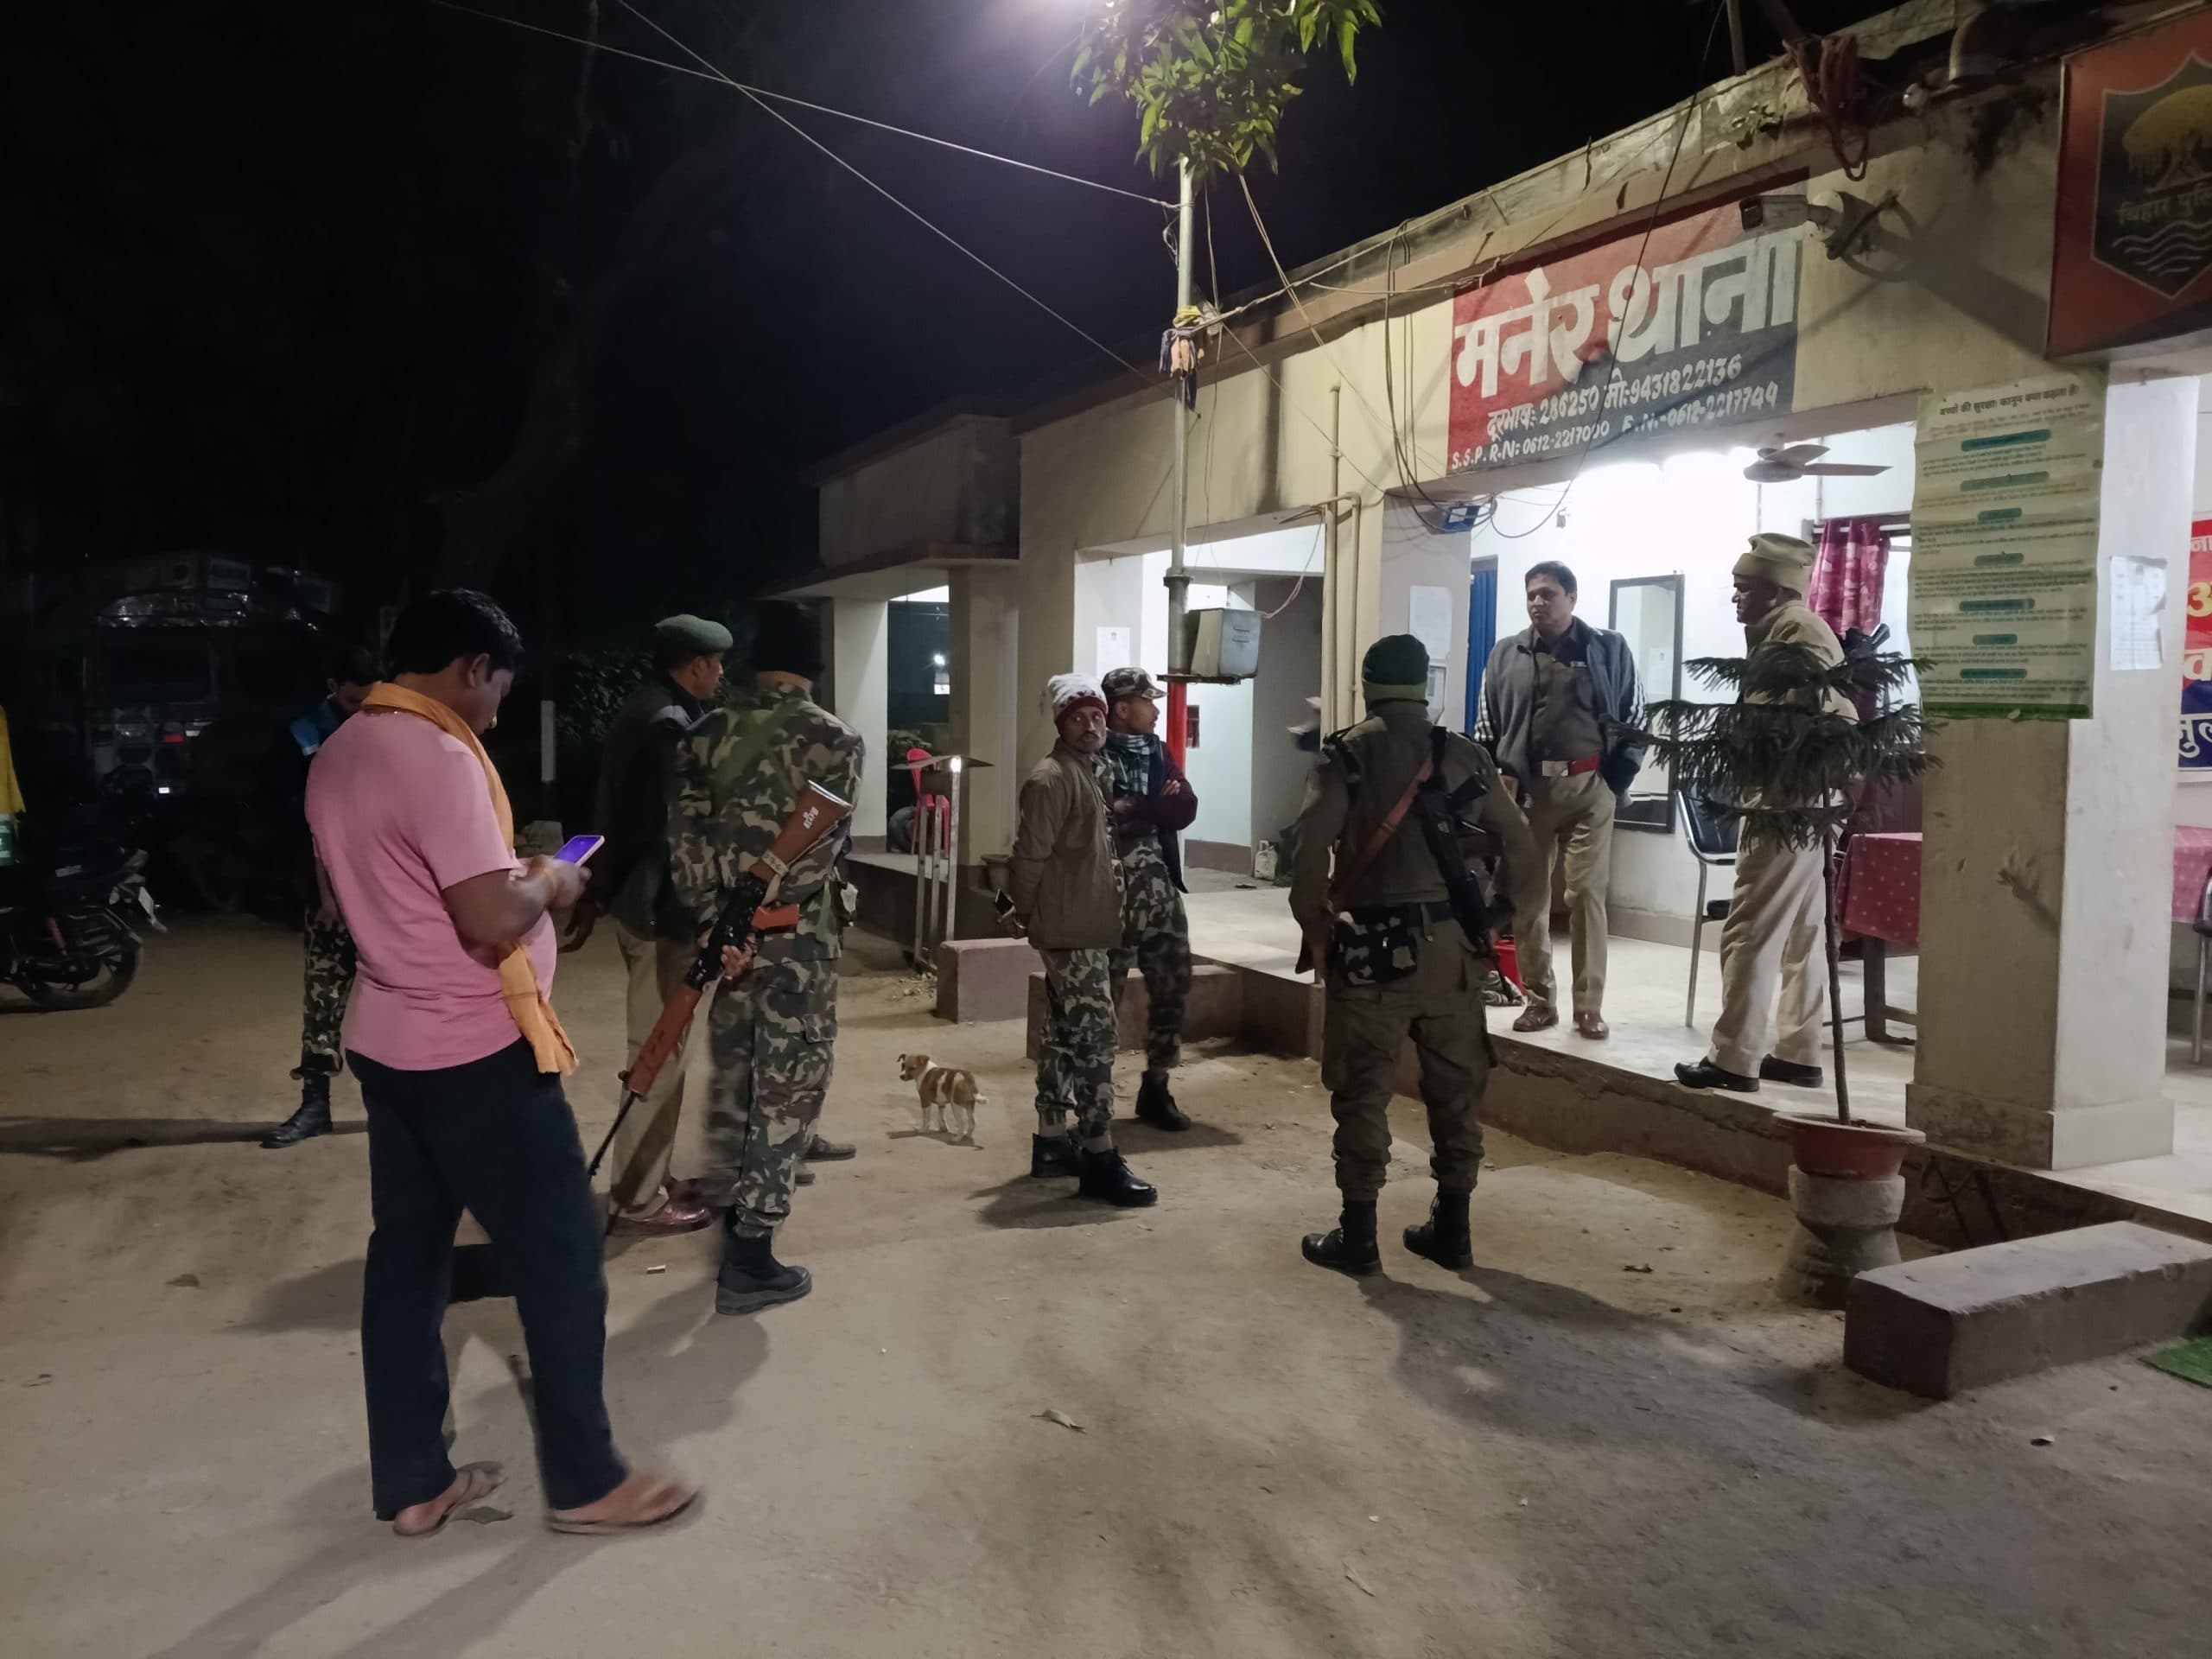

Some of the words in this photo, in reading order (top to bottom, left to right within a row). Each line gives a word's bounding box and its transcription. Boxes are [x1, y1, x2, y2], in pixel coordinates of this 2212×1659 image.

[1454, 267, 1599, 399] मनेर
[1607, 224, 1805, 363] थाना
[1961, 402, 1971, 412] की
